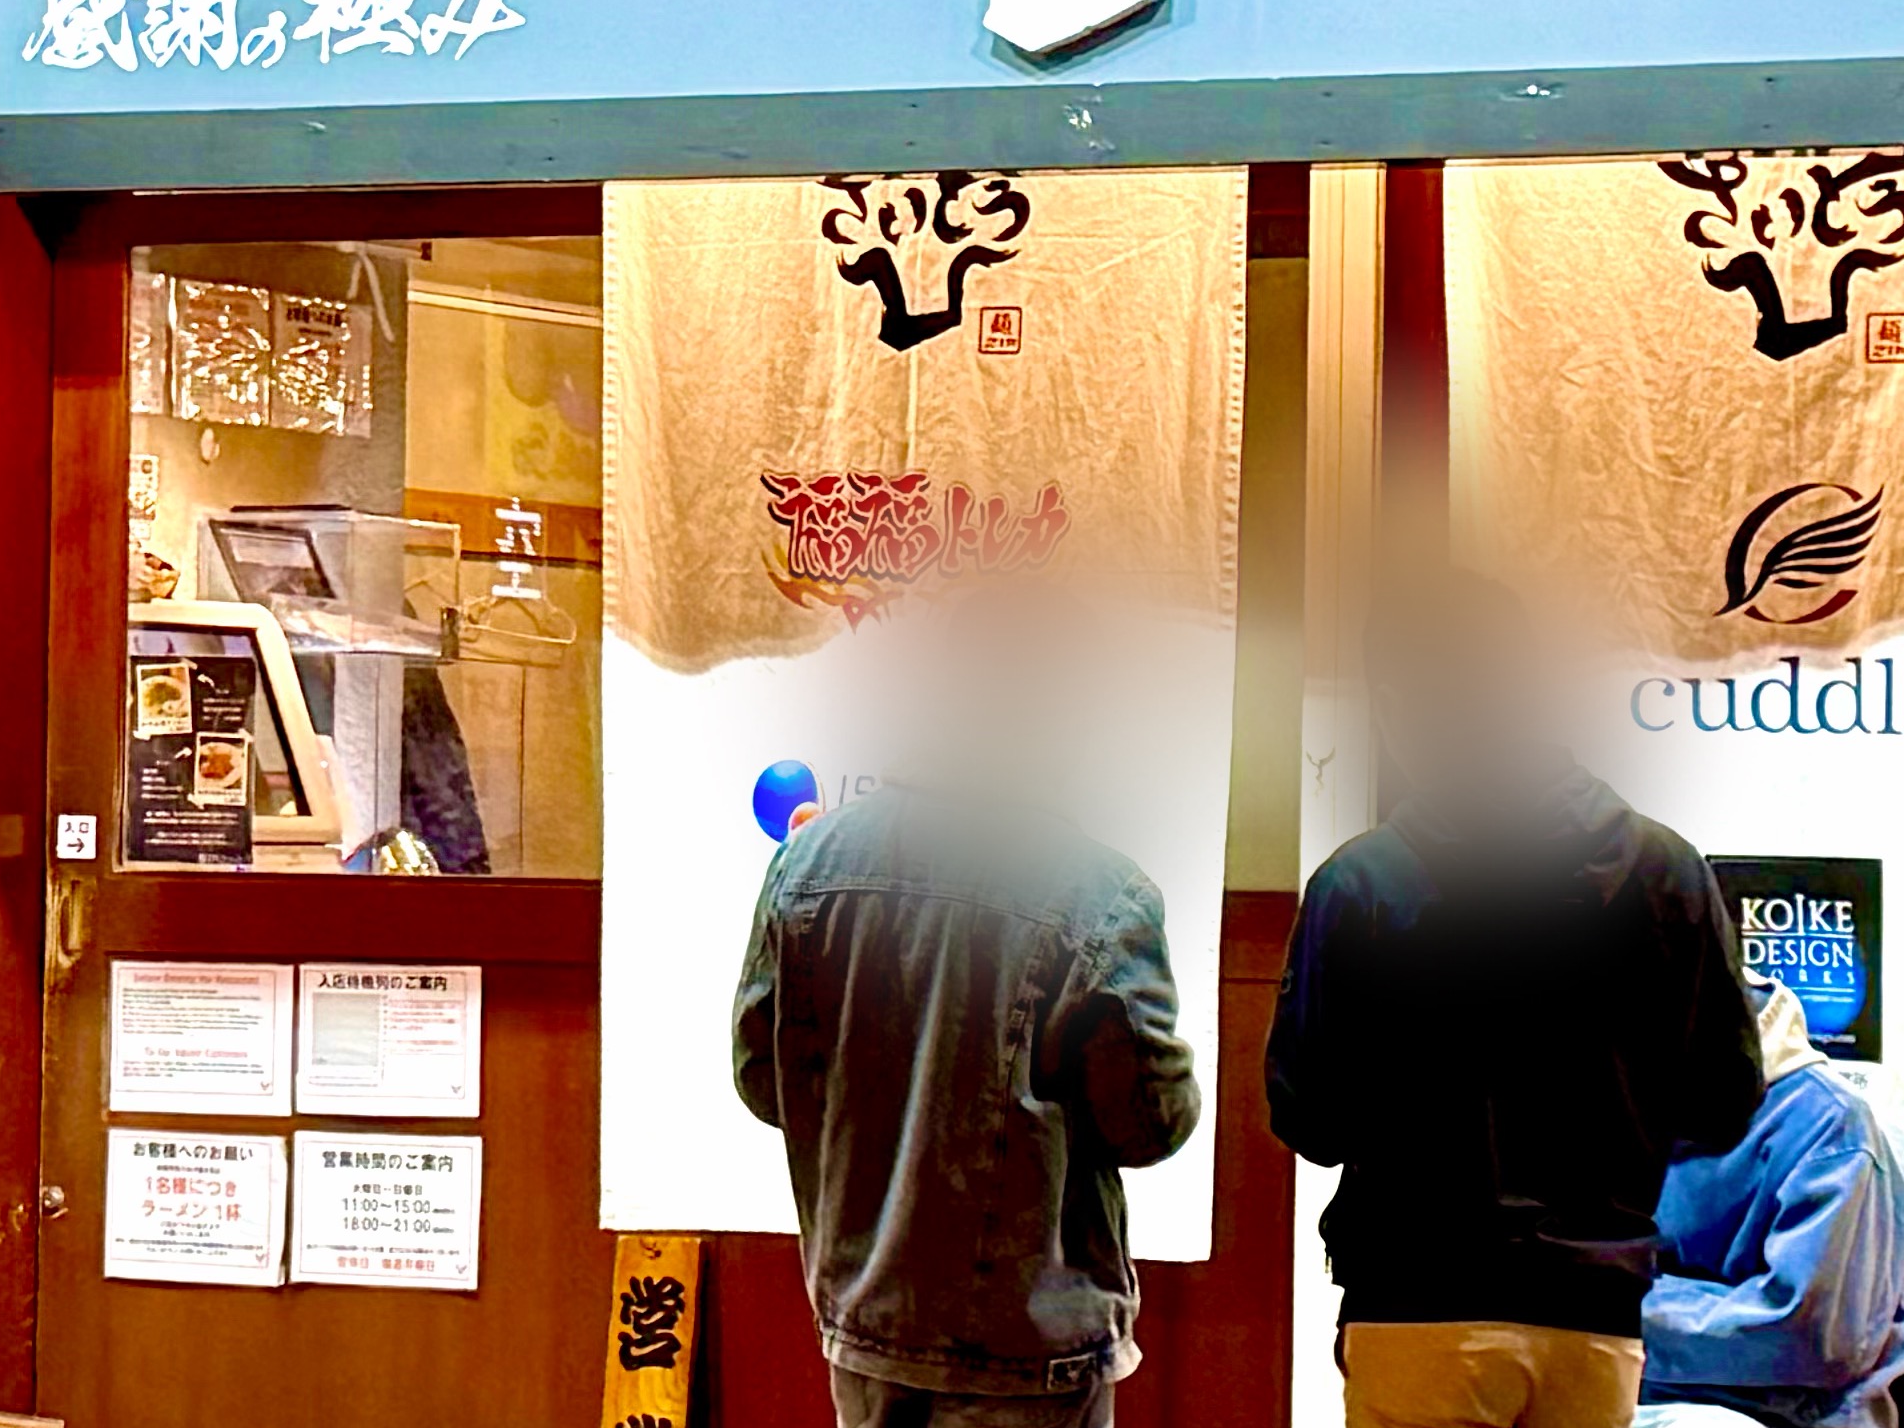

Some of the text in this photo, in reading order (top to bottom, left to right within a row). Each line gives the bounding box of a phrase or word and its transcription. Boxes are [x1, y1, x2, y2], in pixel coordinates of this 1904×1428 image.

[1741, 893, 1854, 935] KOIKE
[1743, 939, 1853, 967] DESIGN
[322, 1151, 453, 1172] 営業時間のご案内
